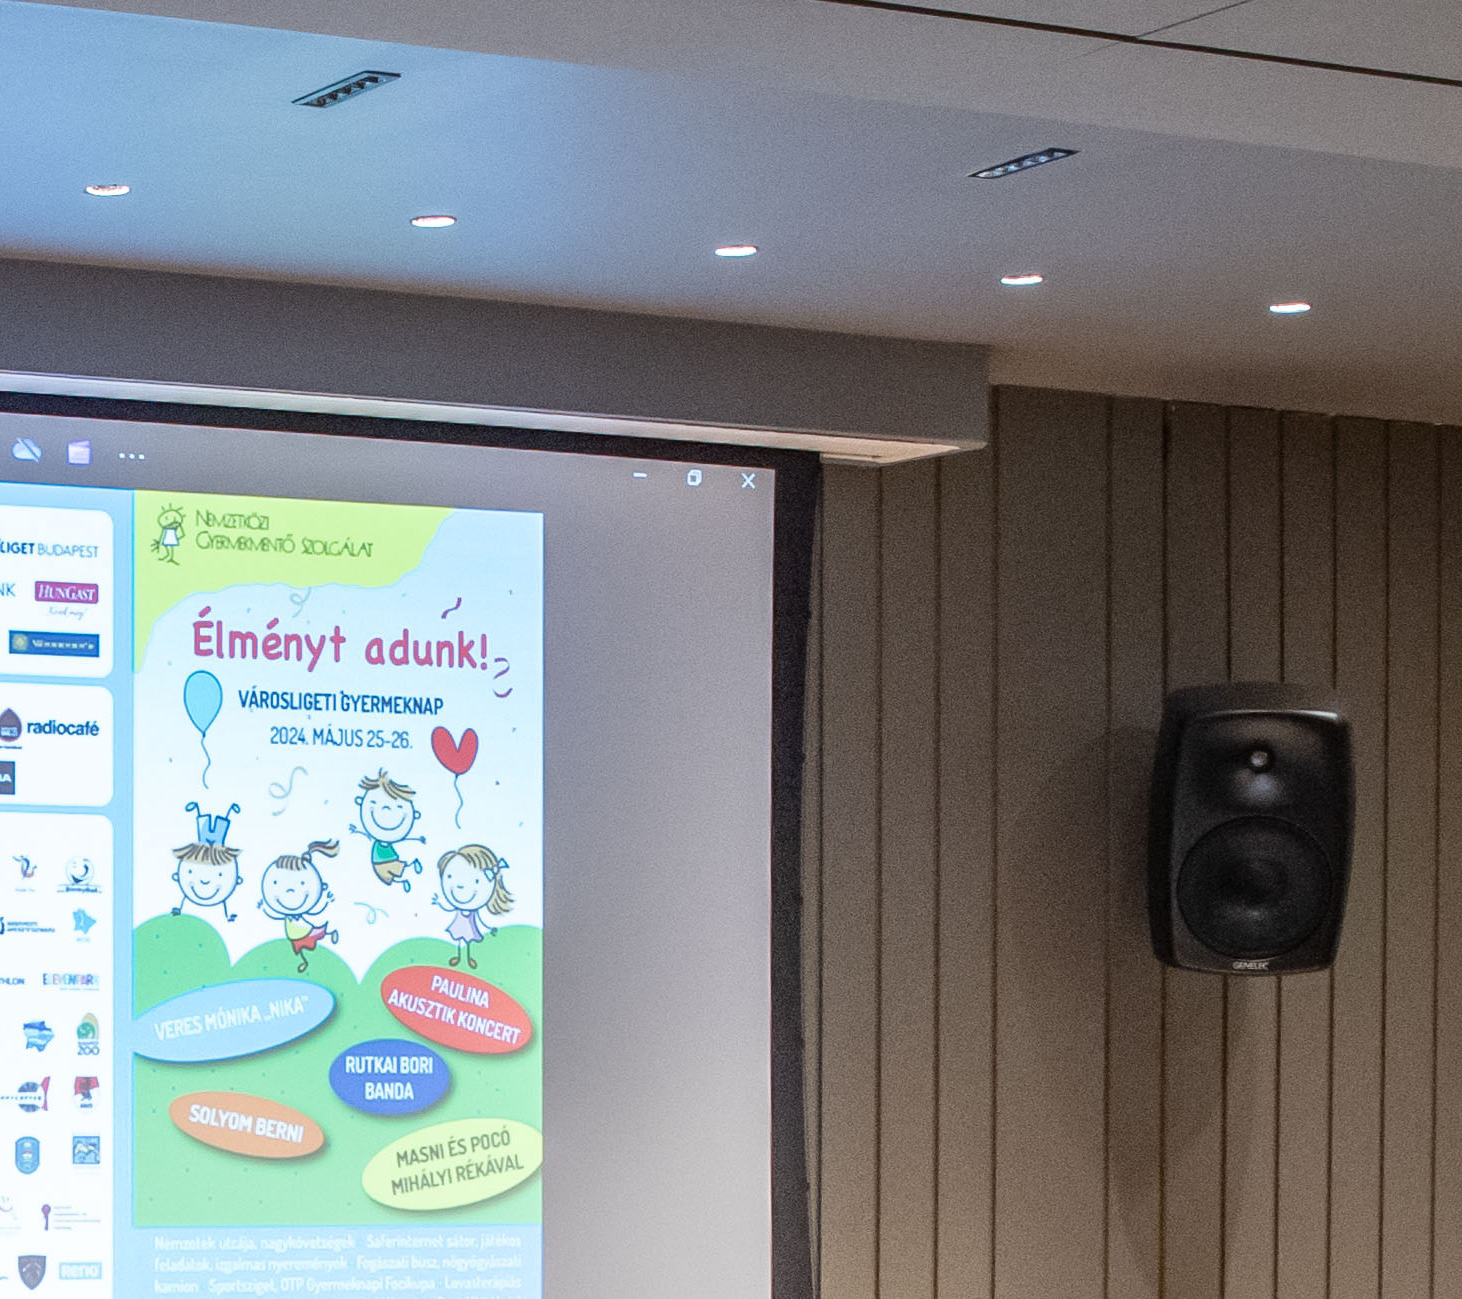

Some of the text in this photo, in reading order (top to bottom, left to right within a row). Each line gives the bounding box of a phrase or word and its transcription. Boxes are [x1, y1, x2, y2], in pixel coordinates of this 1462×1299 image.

[37, 543, 99, 558] BUDAPEST
[192, 605, 489, 673] Élményt adunk!
[237, 685, 444, 717] VÁROSLIGETI GYERMEKNAP
[26, 719, 100, 737] radiocafé
[269, 724, 413, 750] 2024. MÁJUS 25-26.
[431, 974, 489, 1009] PAULINA
[154, 1017, 203, 1042] VERES
[204, 1006, 261, 1033] MÓNIKA
[387, 988, 521, 1045] AKUSZTIK KONCERT
[344, 1056, 434, 1076] RUTKAI BORI
[364, 1081, 415, 1101] BANDA
[255, 1117, 305, 1144] BERNI
[396, 1123, 511, 1168] MASNI ÉS POCÓ
[391, 1153, 525, 1196] MIHÁLYI RÉKÁVAL
